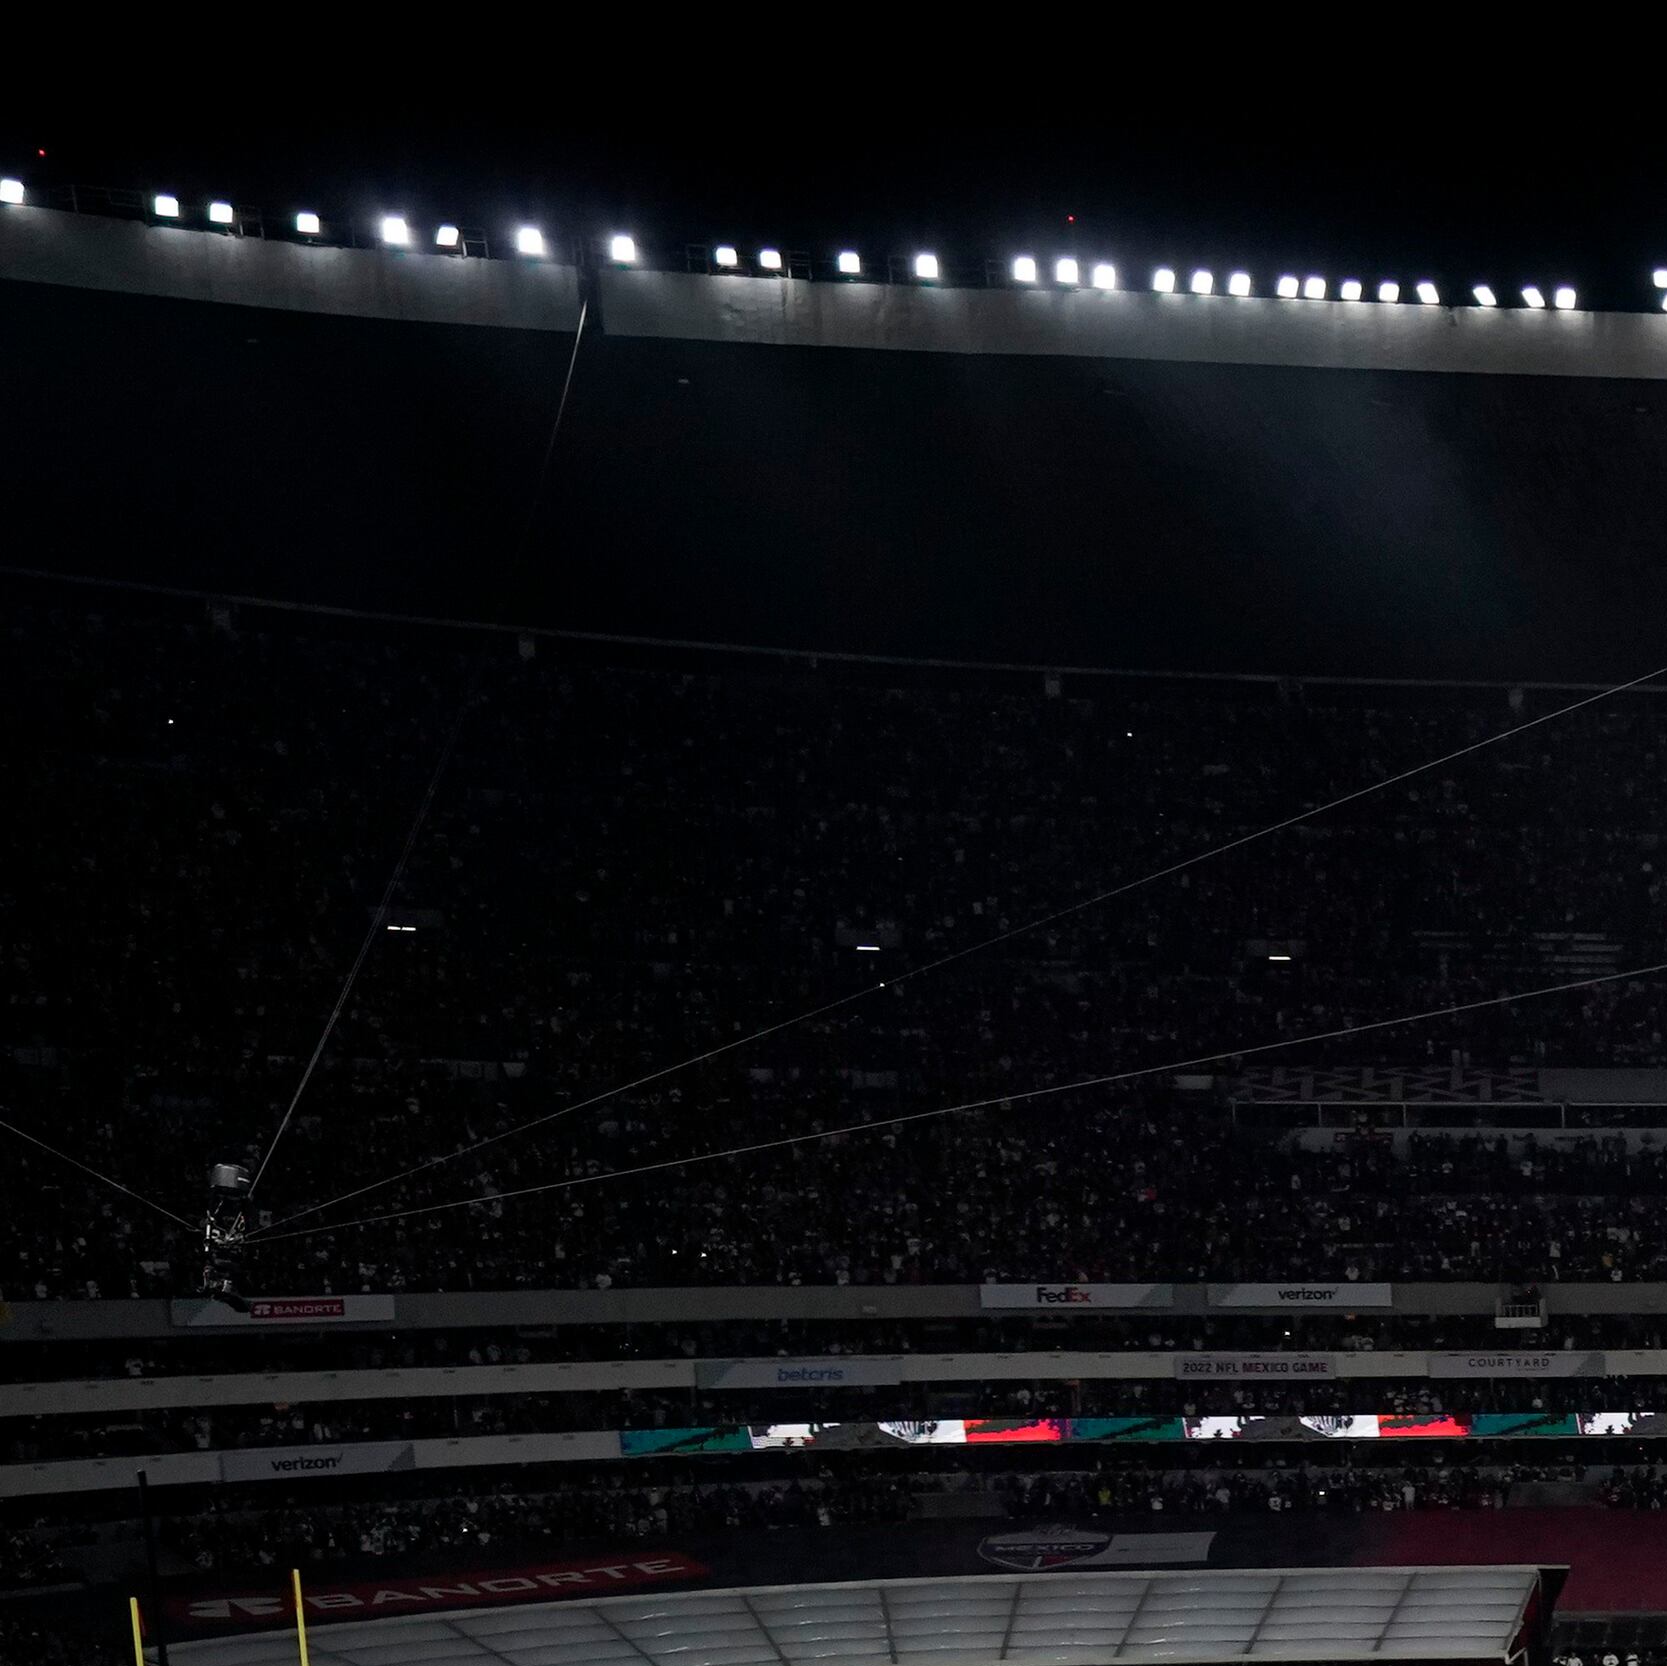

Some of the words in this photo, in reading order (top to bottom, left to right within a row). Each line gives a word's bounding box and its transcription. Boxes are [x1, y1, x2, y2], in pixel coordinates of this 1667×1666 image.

[1037, 1288, 1092, 1303] FedEx
[1278, 1289, 1334, 1302] verizon
[273, 1302, 341, 1315] BANORTE
[1183, 1362, 1212, 1374] 2022
[1216, 1362, 1238, 1374] NFL
[1243, 1362, 1288, 1374] MEXICO
[1292, 1363, 1327, 1374] GAME
[1468, 1359, 1550, 1369] COURTYARD
[778, 1367, 843, 1383] betcris
[272, 1457, 336, 1471] verizon
[995, 1543, 1094, 1554] MEXICO
[307, 1558, 688, 1609] BANORTE
